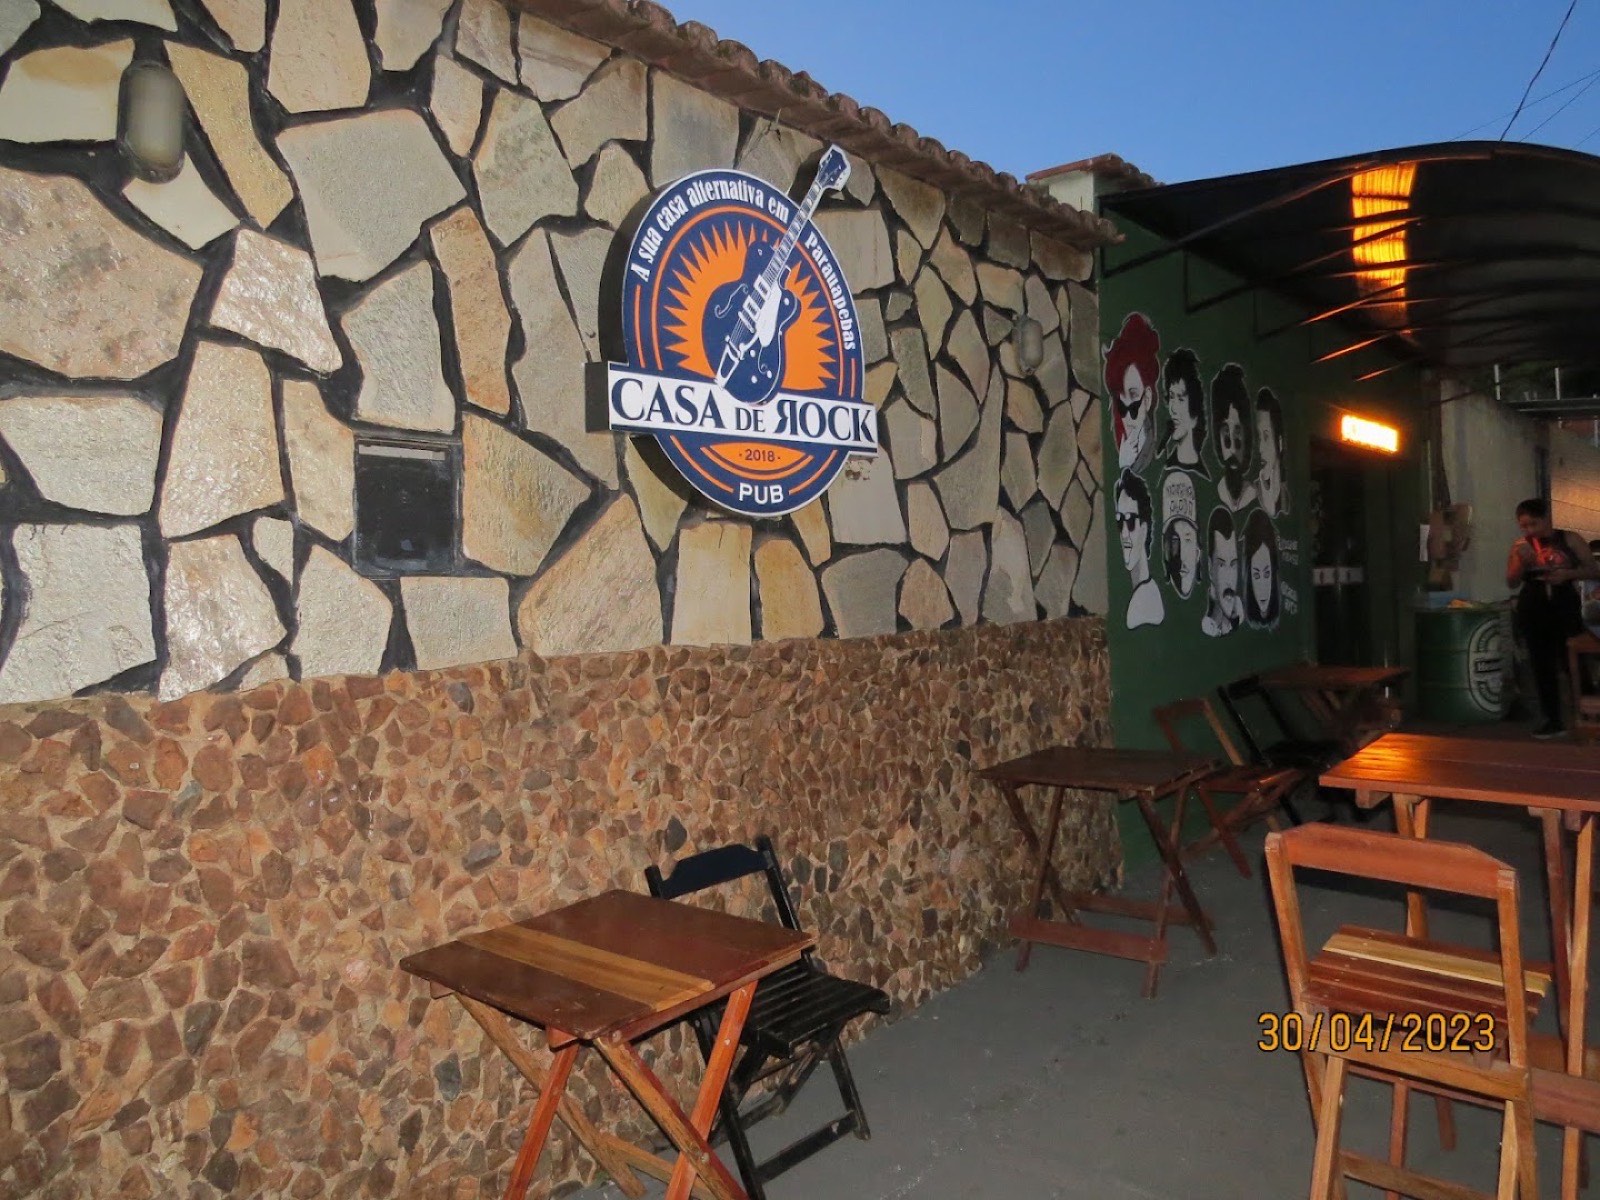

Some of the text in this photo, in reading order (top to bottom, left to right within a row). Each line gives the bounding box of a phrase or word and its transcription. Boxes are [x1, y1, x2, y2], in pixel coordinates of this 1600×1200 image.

[631, 179, 856, 351] A sua casa alternativa em Parauapebas
[611, 380, 727, 429] CASA
[735, 407, 766, 433] DE
[744, 449, 776, 462] 2018
[739, 482, 784, 505] PUB
